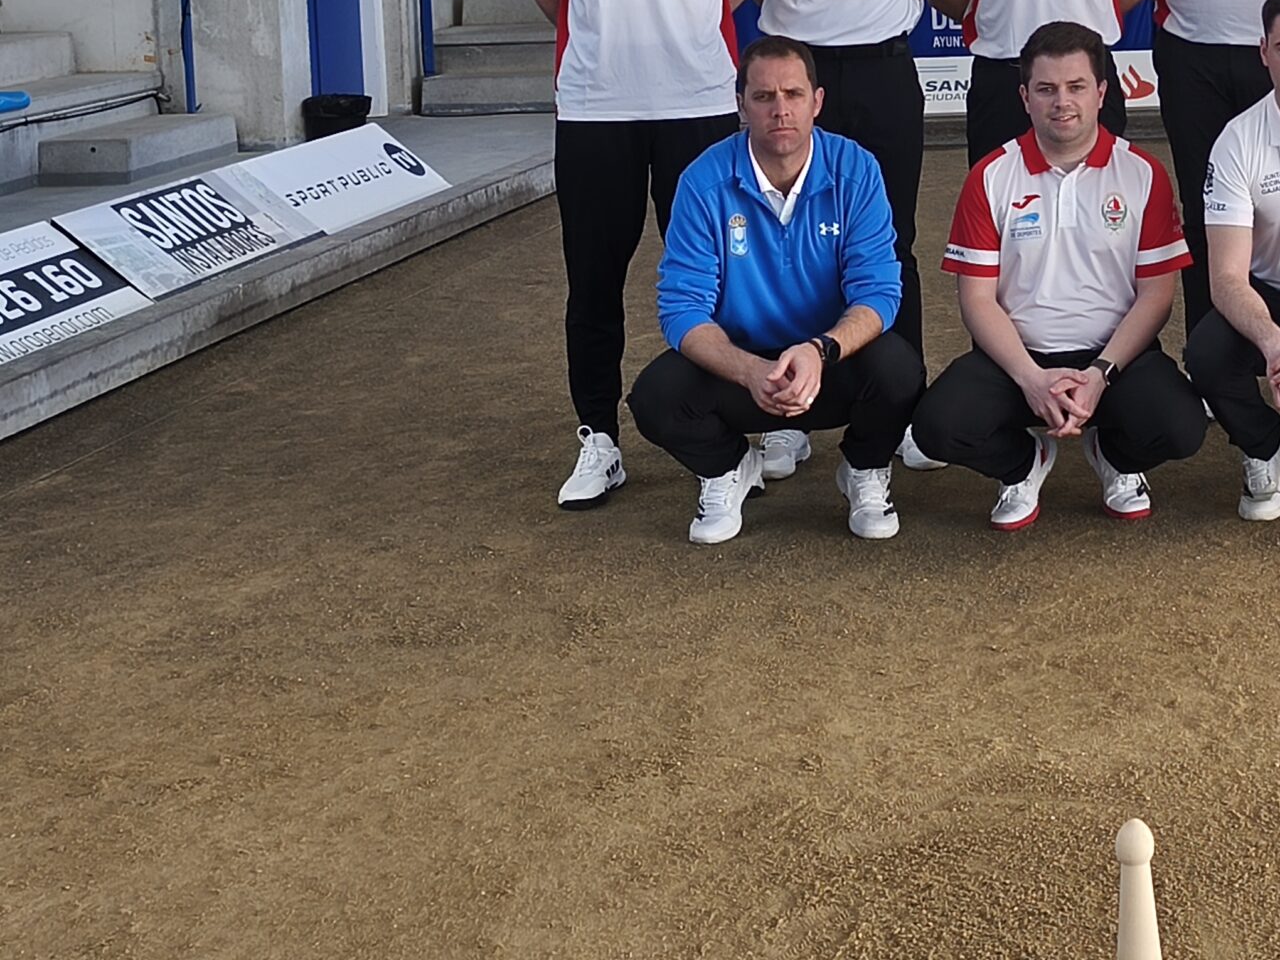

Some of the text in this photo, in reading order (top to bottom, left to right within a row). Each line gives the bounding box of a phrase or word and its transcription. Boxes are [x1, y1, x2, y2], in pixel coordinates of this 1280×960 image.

[119, 184, 246, 249] SANTOS
[171, 224, 277, 276] INSTALADORES
[23, 258, 103, 303] 160
